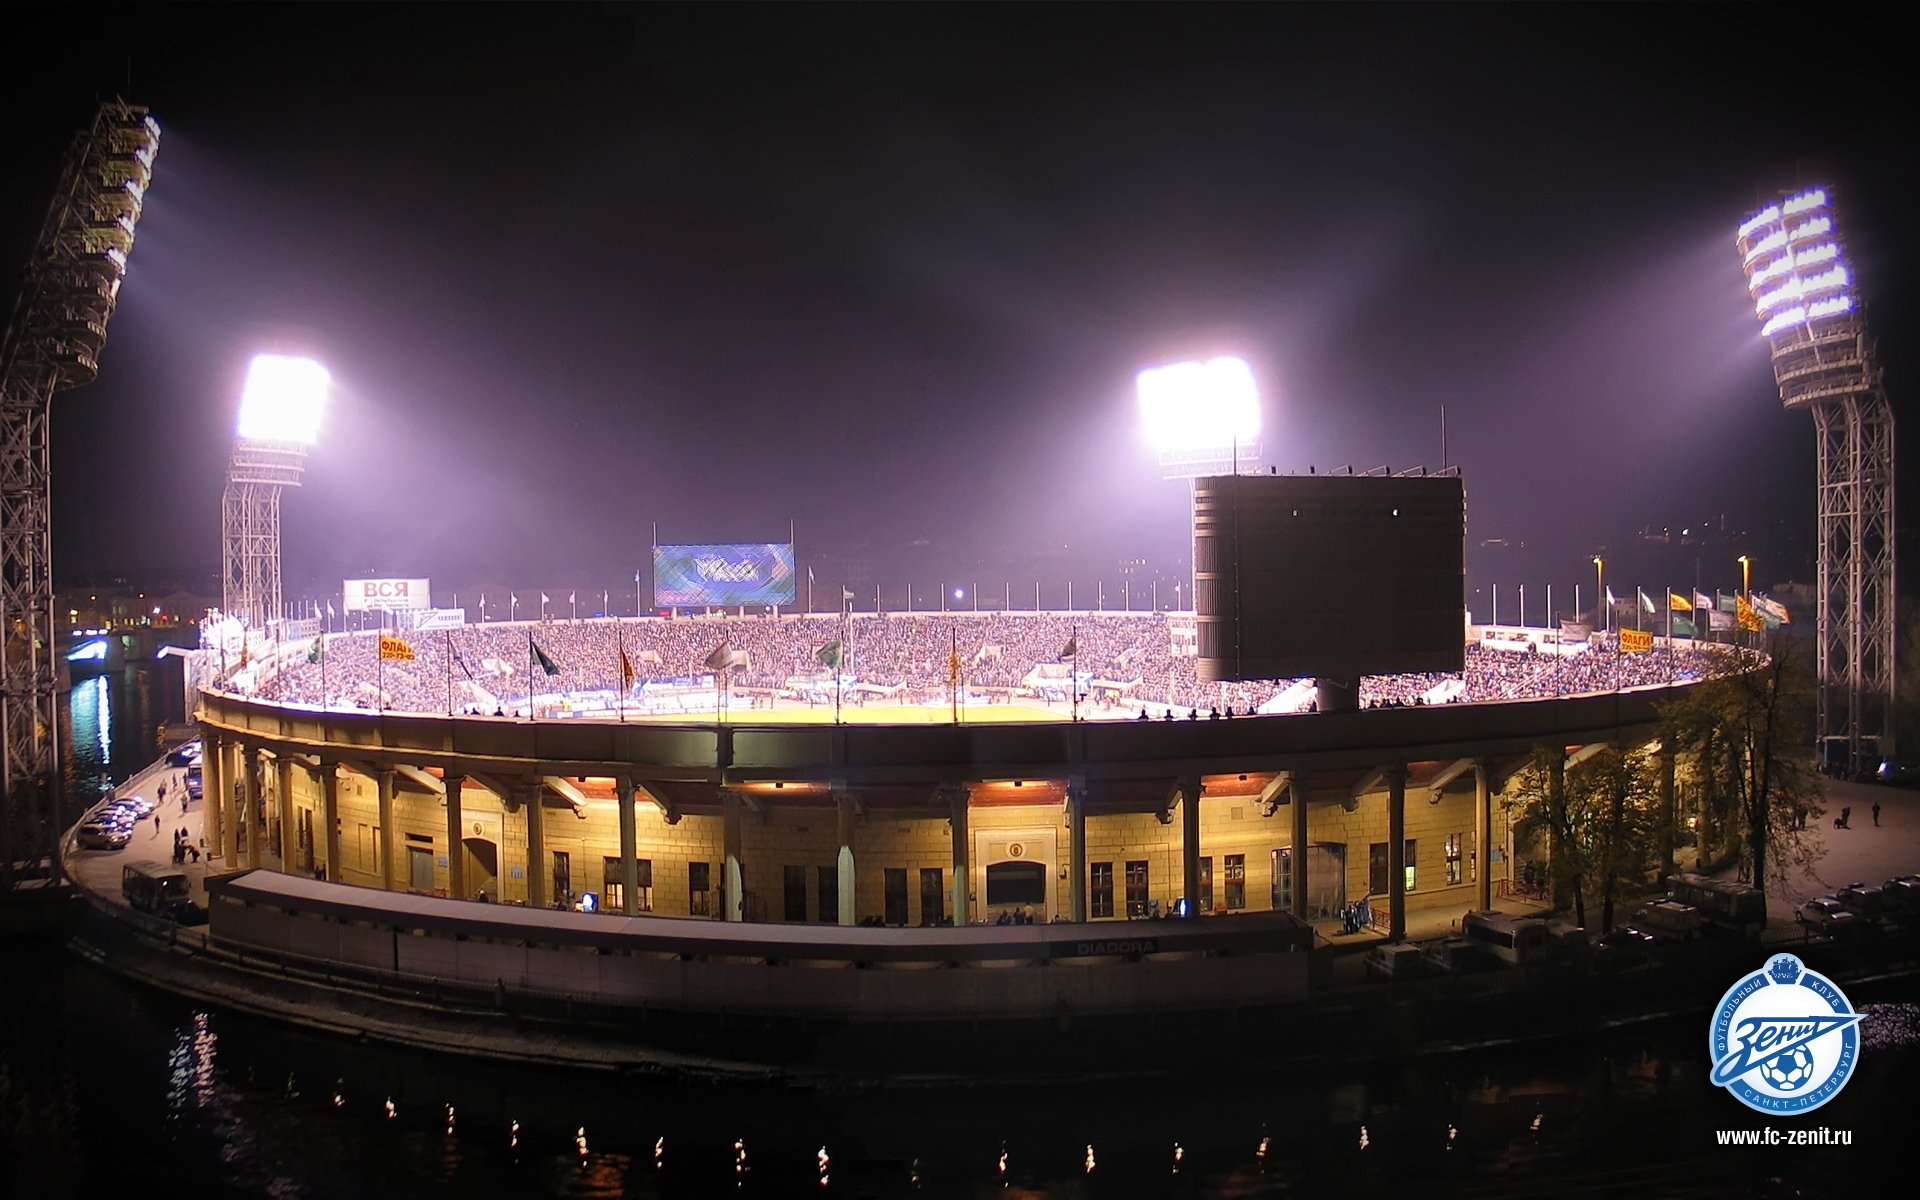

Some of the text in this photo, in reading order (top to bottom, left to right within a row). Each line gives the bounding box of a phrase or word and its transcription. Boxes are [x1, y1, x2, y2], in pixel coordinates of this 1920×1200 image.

[364, 582, 408, 597] ВСЯ
[382, 641, 414, 653] ФЛА
[1078, 941, 1153, 955] DIADORA
